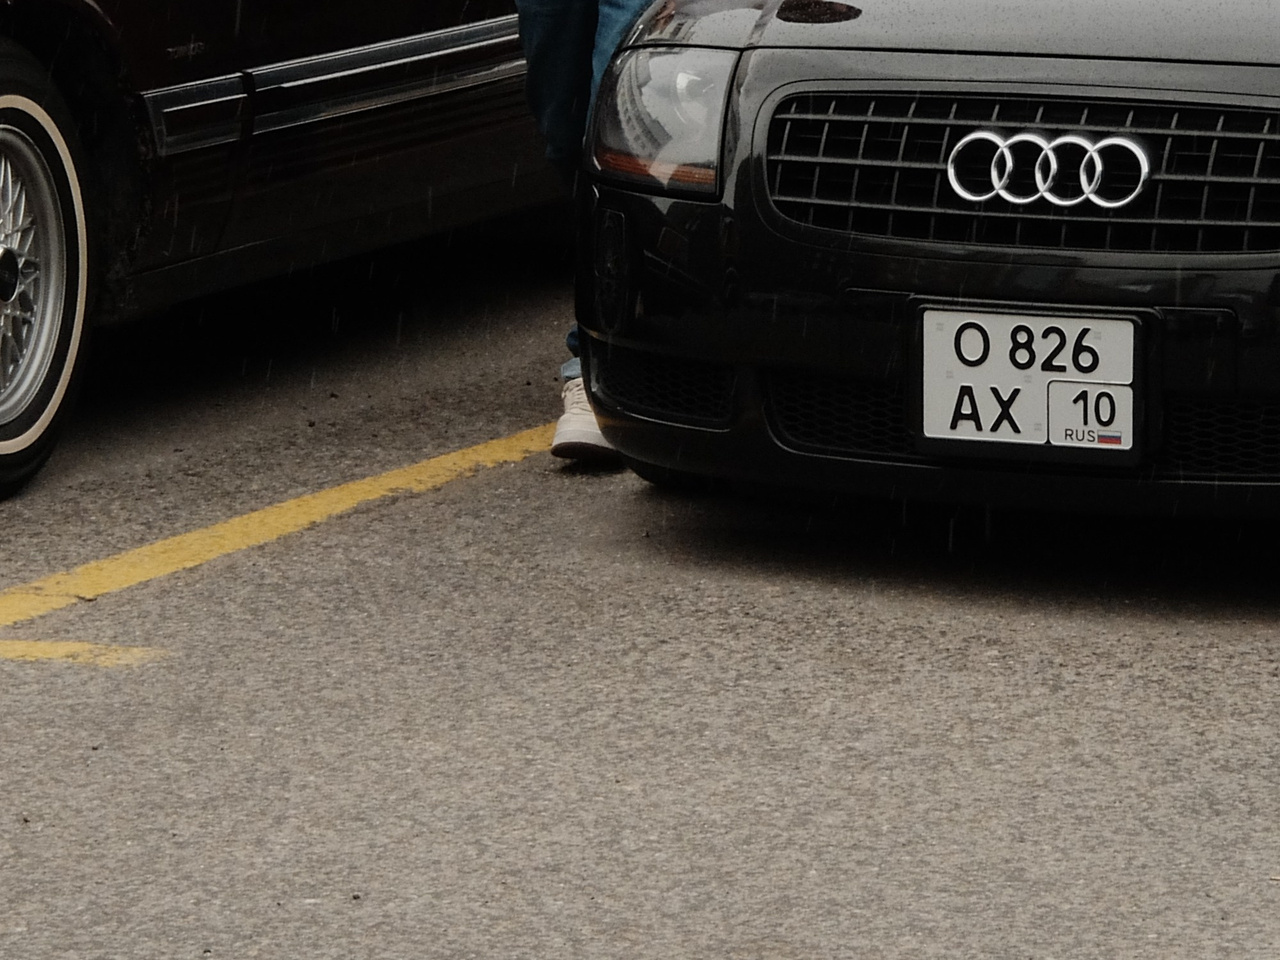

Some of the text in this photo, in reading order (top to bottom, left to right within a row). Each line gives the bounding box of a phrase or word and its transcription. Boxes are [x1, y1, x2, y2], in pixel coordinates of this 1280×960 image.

[1009, 324, 1100, 374] 826
[1072, 389, 1116, 427] 10
[1064, 428, 1097, 442] RUS
